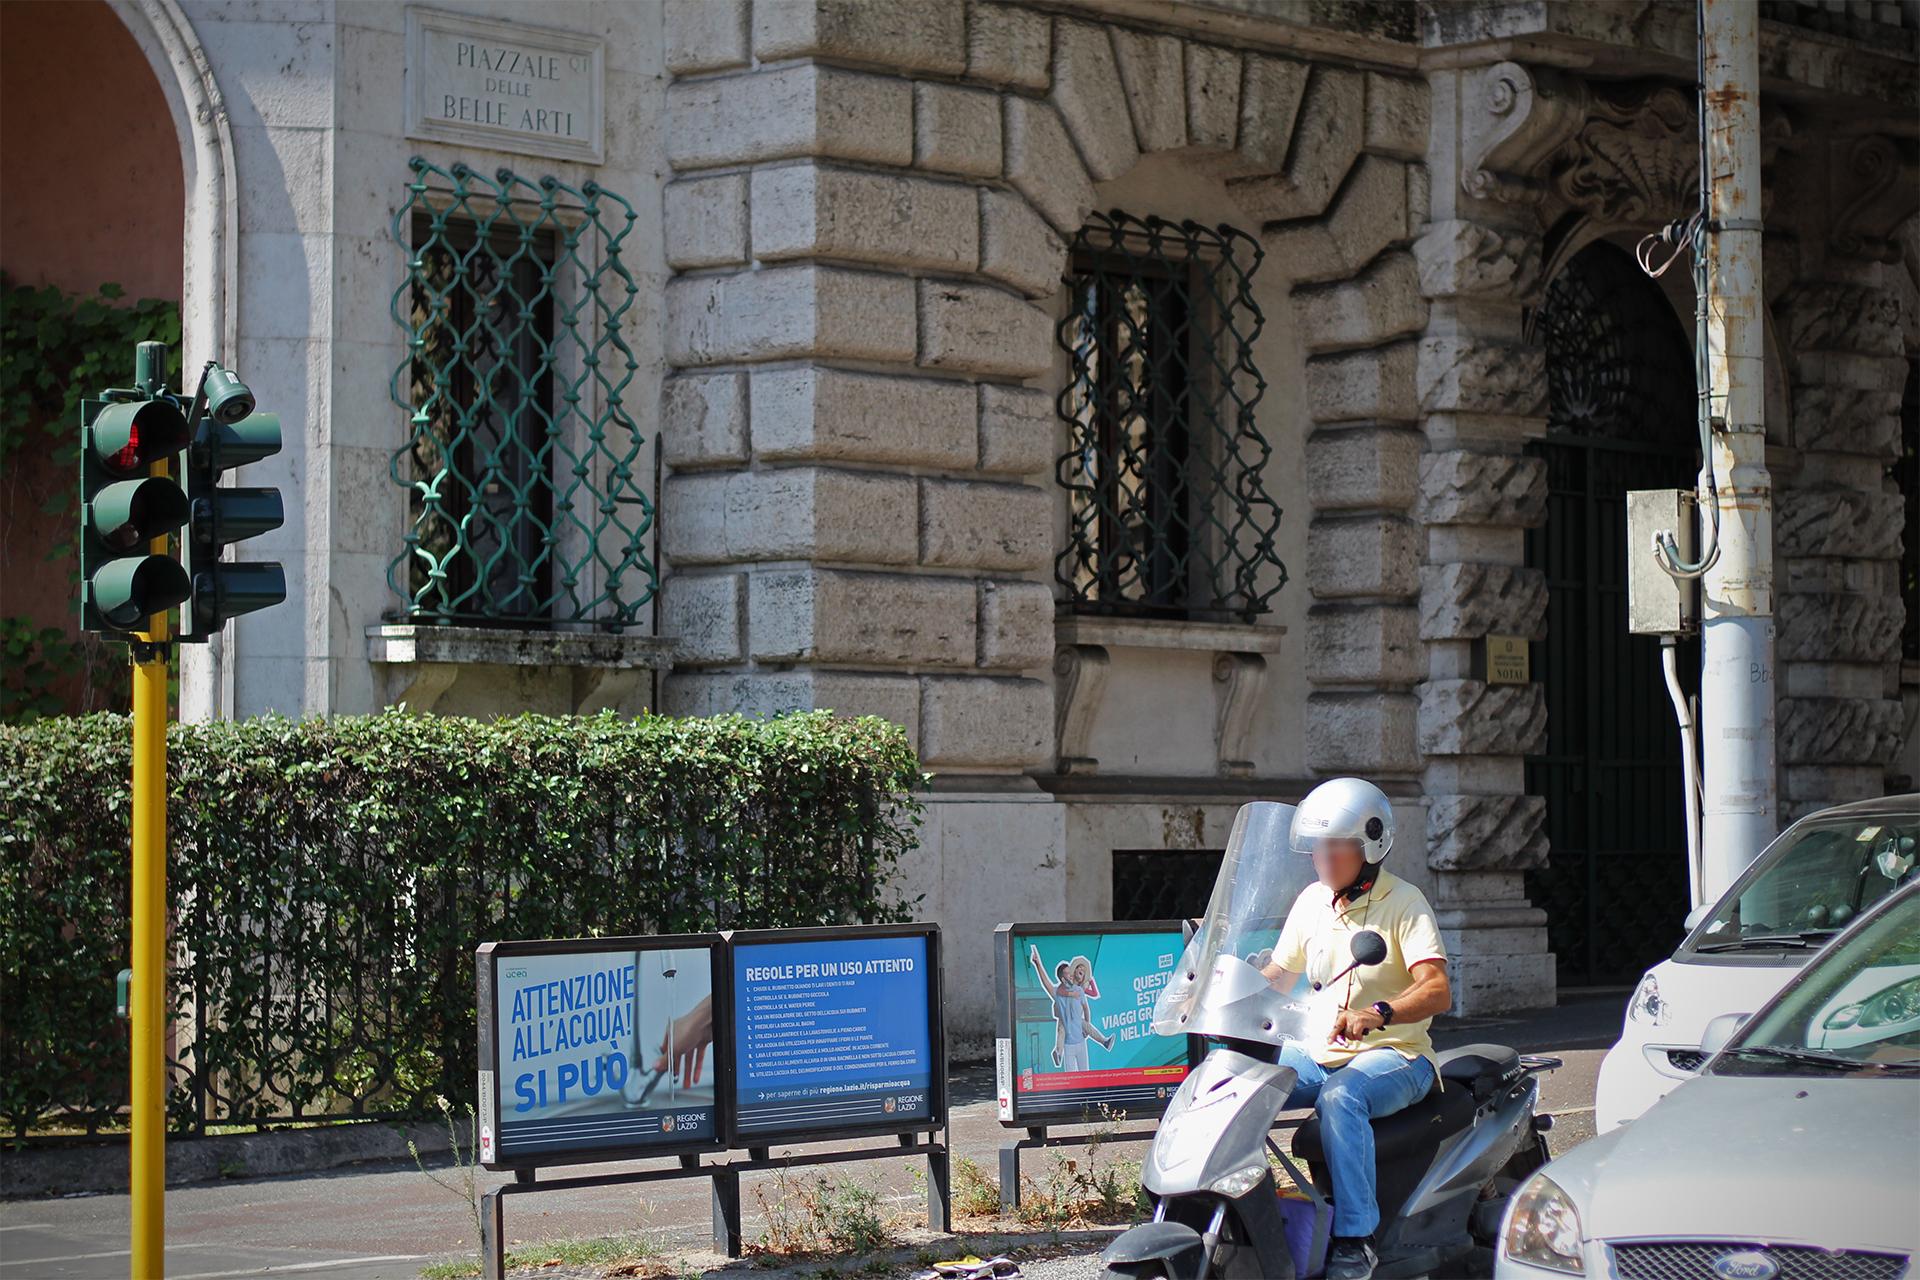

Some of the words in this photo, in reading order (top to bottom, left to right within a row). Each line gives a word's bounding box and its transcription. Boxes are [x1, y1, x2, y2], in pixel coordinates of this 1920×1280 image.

[457, 42, 560, 80] PIAZZALE
[485, 77, 533, 98] DELLE
[443, 94, 509, 126] BELLE
[520, 108, 571, 135] ARTI
[746, 965, 794, 982] REGOLE
[796, 963, 819, 979] PER
[821, 962, 838, 977] UN
[840, 960, 863, 976] USO
[864, 958, 914, 974] ATTENTO
[511, 965, 634, 1024] ATTENZIONE
[1102, 1009, 1136, 1030] VIAGGI
[1138, 1007, 1153, 1021] GR
[512, 1003, 632, 1062] ALL'ACQUA!
[1120, 1025, 1140, 1041] NEL
[514, 1068, 547, 1113] SI
[557, 1040, 628, 1104] PUÒ
[897, 1094, 924, 1104] REGIONE
[898, 1103, 916, 1112] LAZIO
[677, 1112, 707, 1122] REGIONE
[677, 1122, 698, 1131] LAZIO
[1726, 1260, 1761, 1276] Ford
